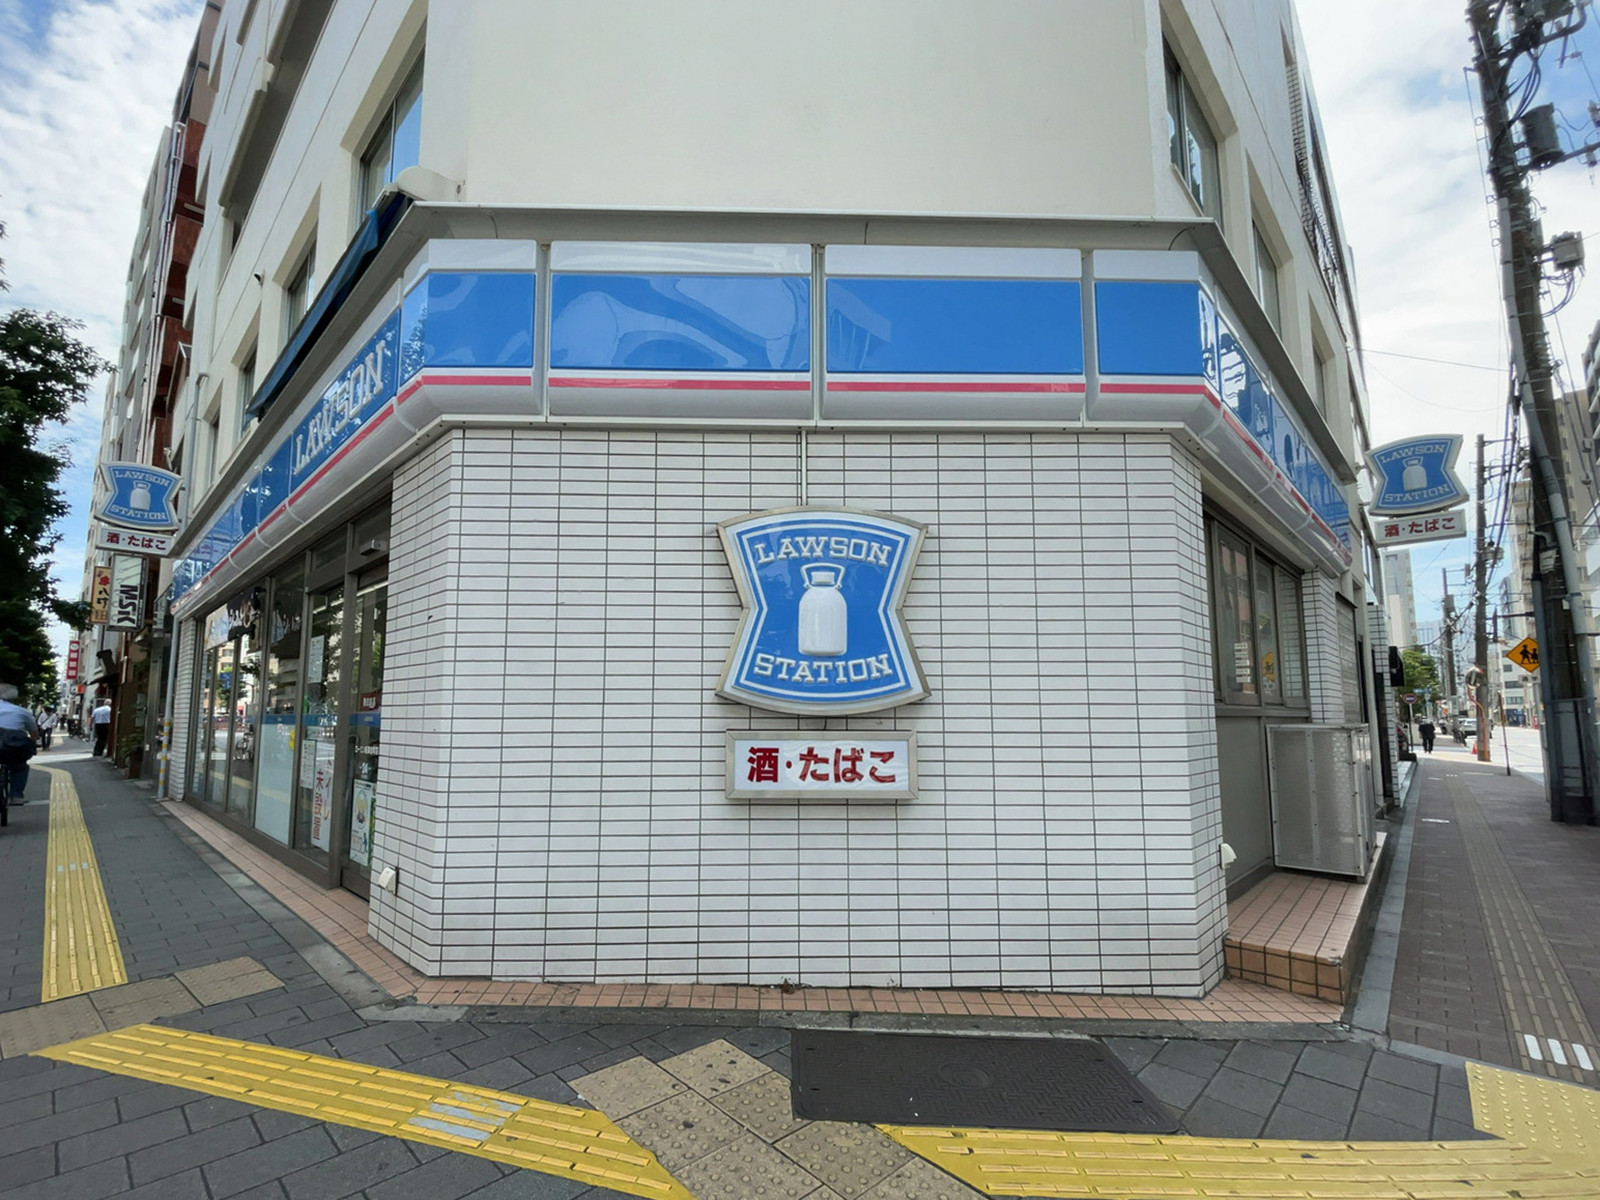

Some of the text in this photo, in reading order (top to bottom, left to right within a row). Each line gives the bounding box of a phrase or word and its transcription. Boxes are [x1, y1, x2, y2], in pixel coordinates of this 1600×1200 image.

[293, 339, 386, 475] LAWSON
[1379, 443, 1446, 464] LAWSON
[114, 470, 170, 487] LAWSON
[1384, 483, 1451, 502] STATION
[110, 504, 167, 520] STATION
[1384, 517, 1456, 537] 酒・たばこ
[754, 536, 892, 567] LAWSON
[753, 652, 893, 683] STATION
[747, 746, 896, 783] 酒・たばこ
